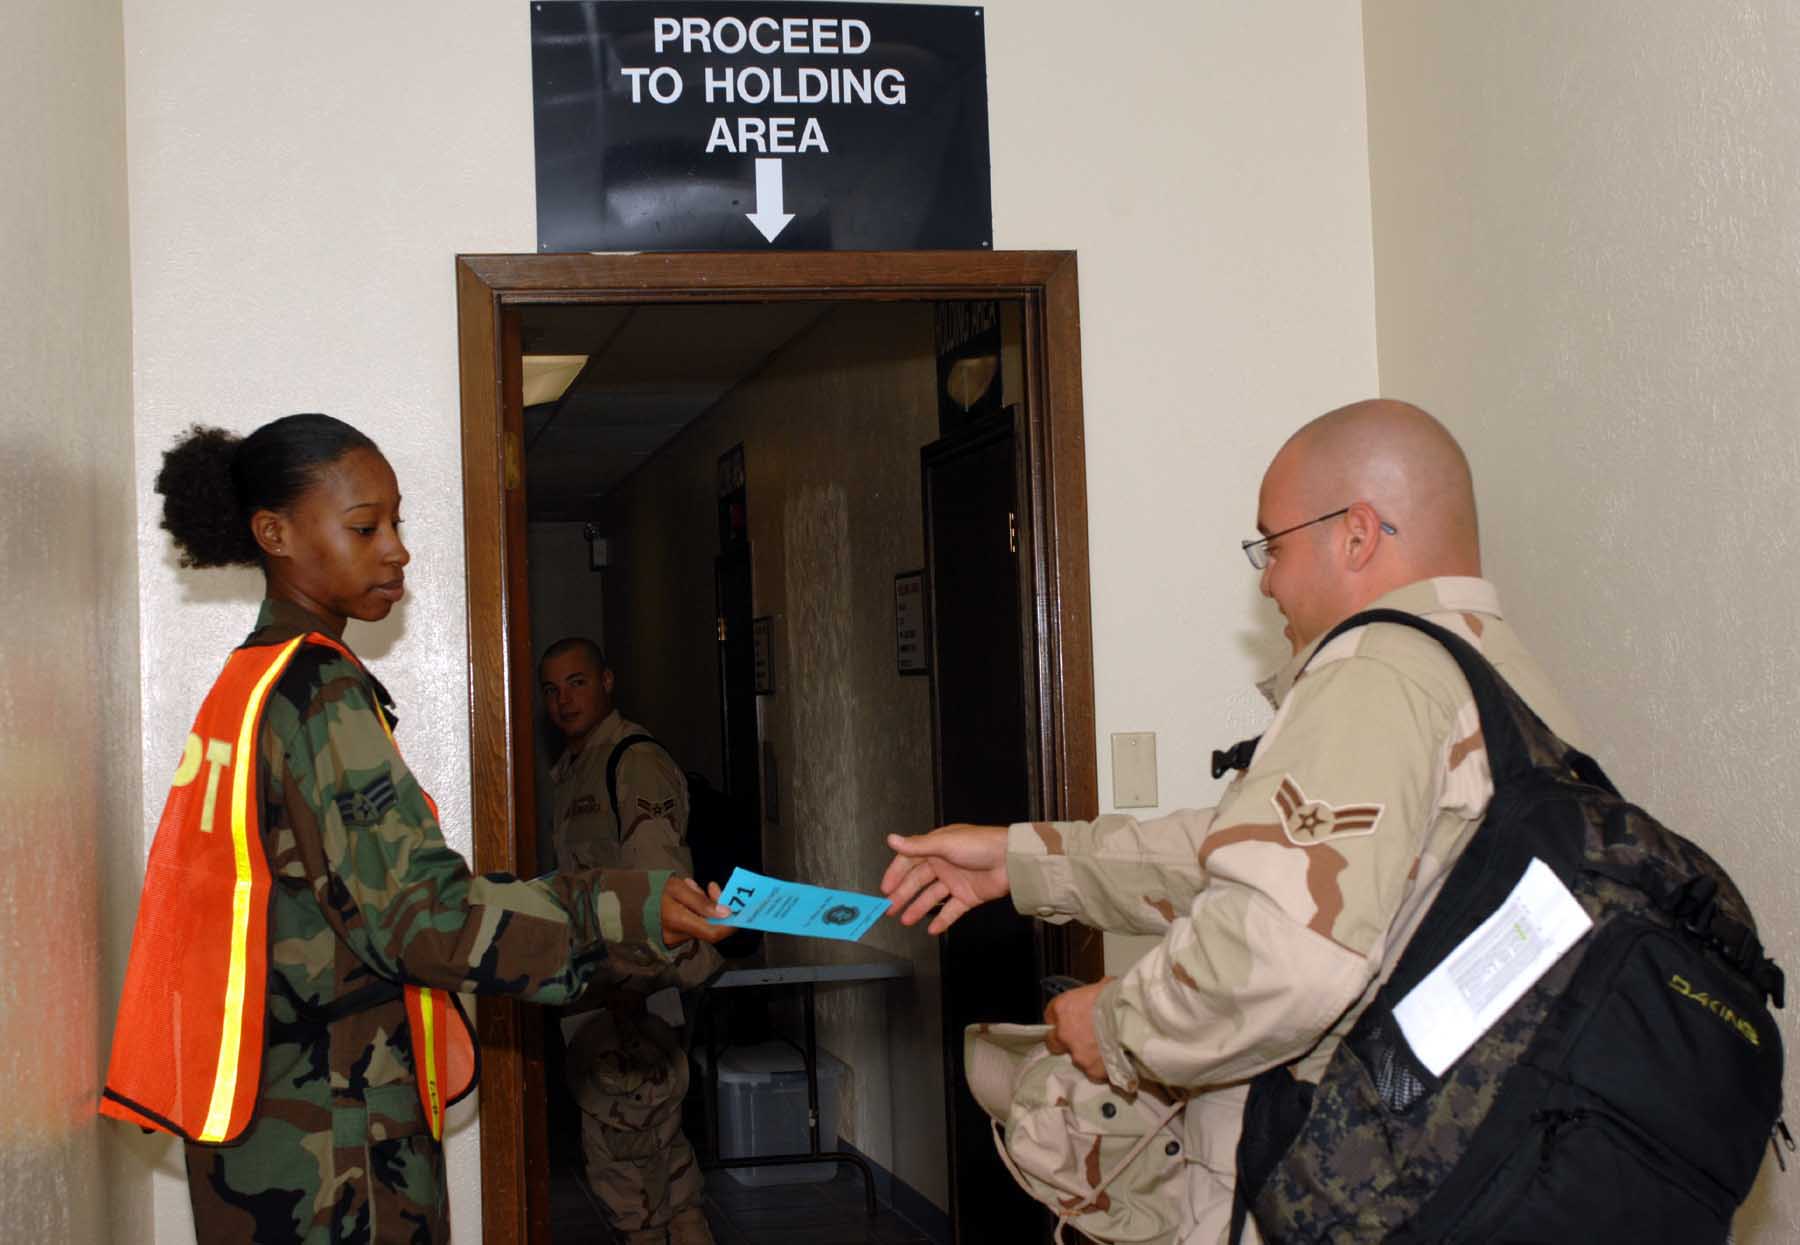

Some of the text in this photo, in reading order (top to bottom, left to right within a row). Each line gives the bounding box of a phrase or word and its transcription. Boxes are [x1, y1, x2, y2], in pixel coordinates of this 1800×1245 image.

[653, 16, 871, 55] PROCEED
[621, 66, 907, 105] TO HOLDING
[705, 117, 829, 153] AREA
